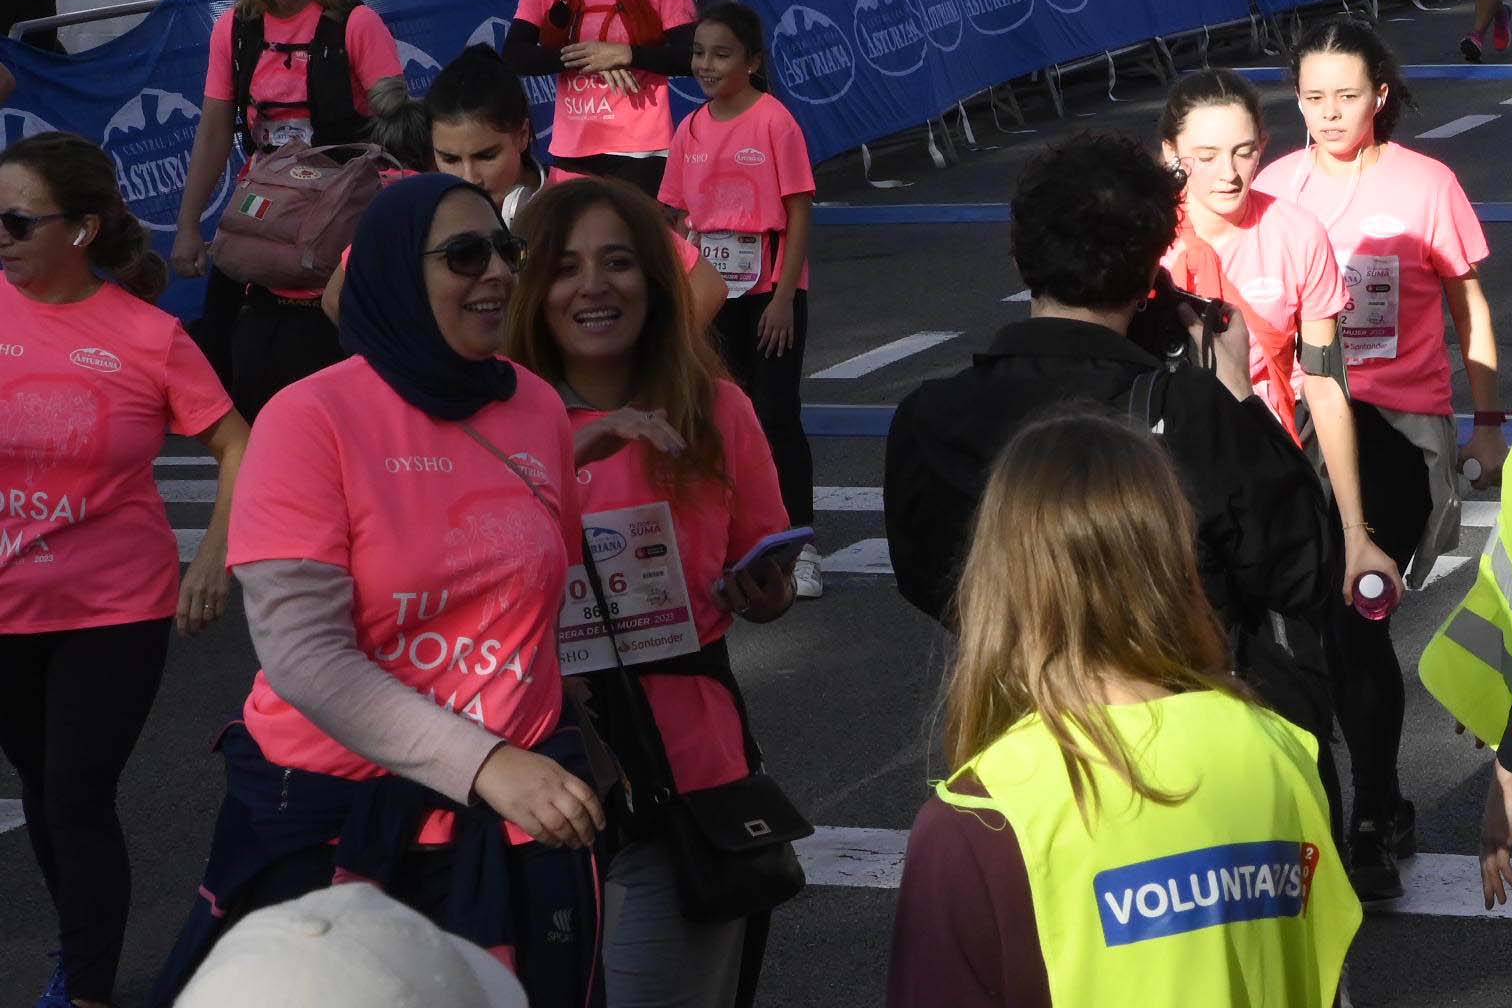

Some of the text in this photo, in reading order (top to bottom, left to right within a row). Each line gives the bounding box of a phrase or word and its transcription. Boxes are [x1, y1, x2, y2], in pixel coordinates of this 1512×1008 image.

[703, 246, 730, 259] 016
[385, 455, 454, 474] OYSHO
[630, 526, 661, 537] SUMA
[569, 572, 628, 601] 06
[392, 590, 448, 625] TU
[583, 602, 620, 620] 868
[586, 626, 600, 636] DE
[616, 618, 650, 631] MUJER
[631, 631, 684, 651] Santander
